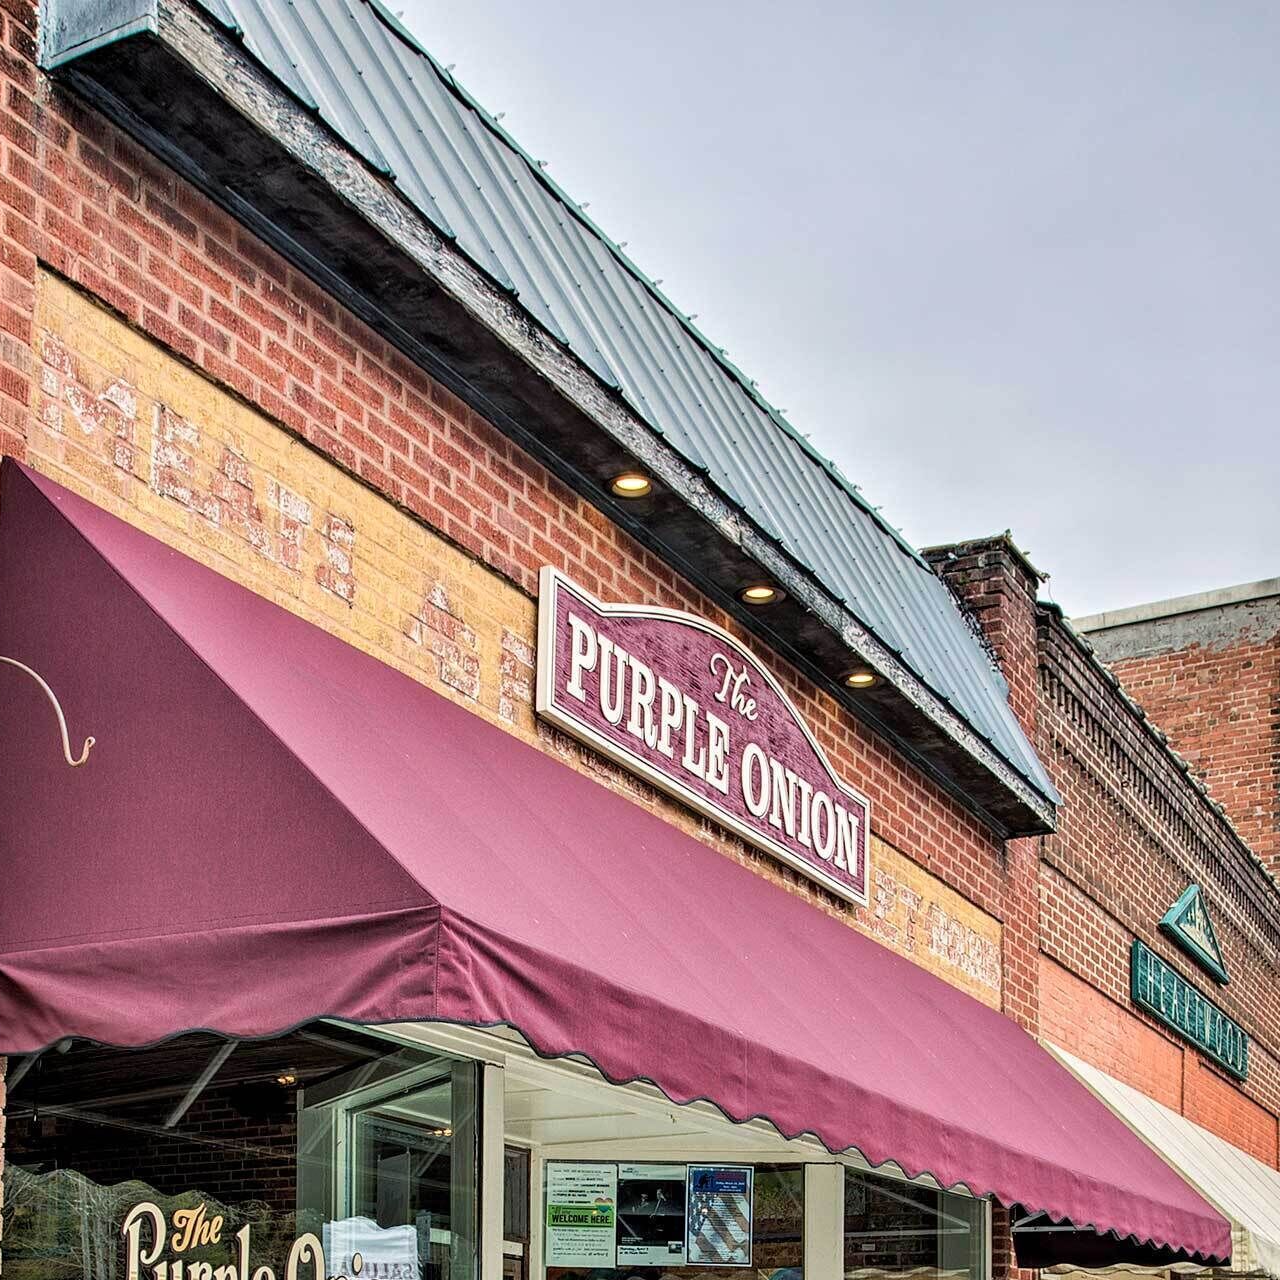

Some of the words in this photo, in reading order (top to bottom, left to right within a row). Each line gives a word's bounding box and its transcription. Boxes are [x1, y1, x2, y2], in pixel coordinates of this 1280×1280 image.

[709, 652, 759, 722] The
[566, 611, 732, 796] PURPLE
[741, 741, 862, 879] ONION
[1146, 952, 1244, 1071] HEARTWOOD
[172, 1203, 224, 1253] The
[552, 1214, 589, 1224] WELCOME
